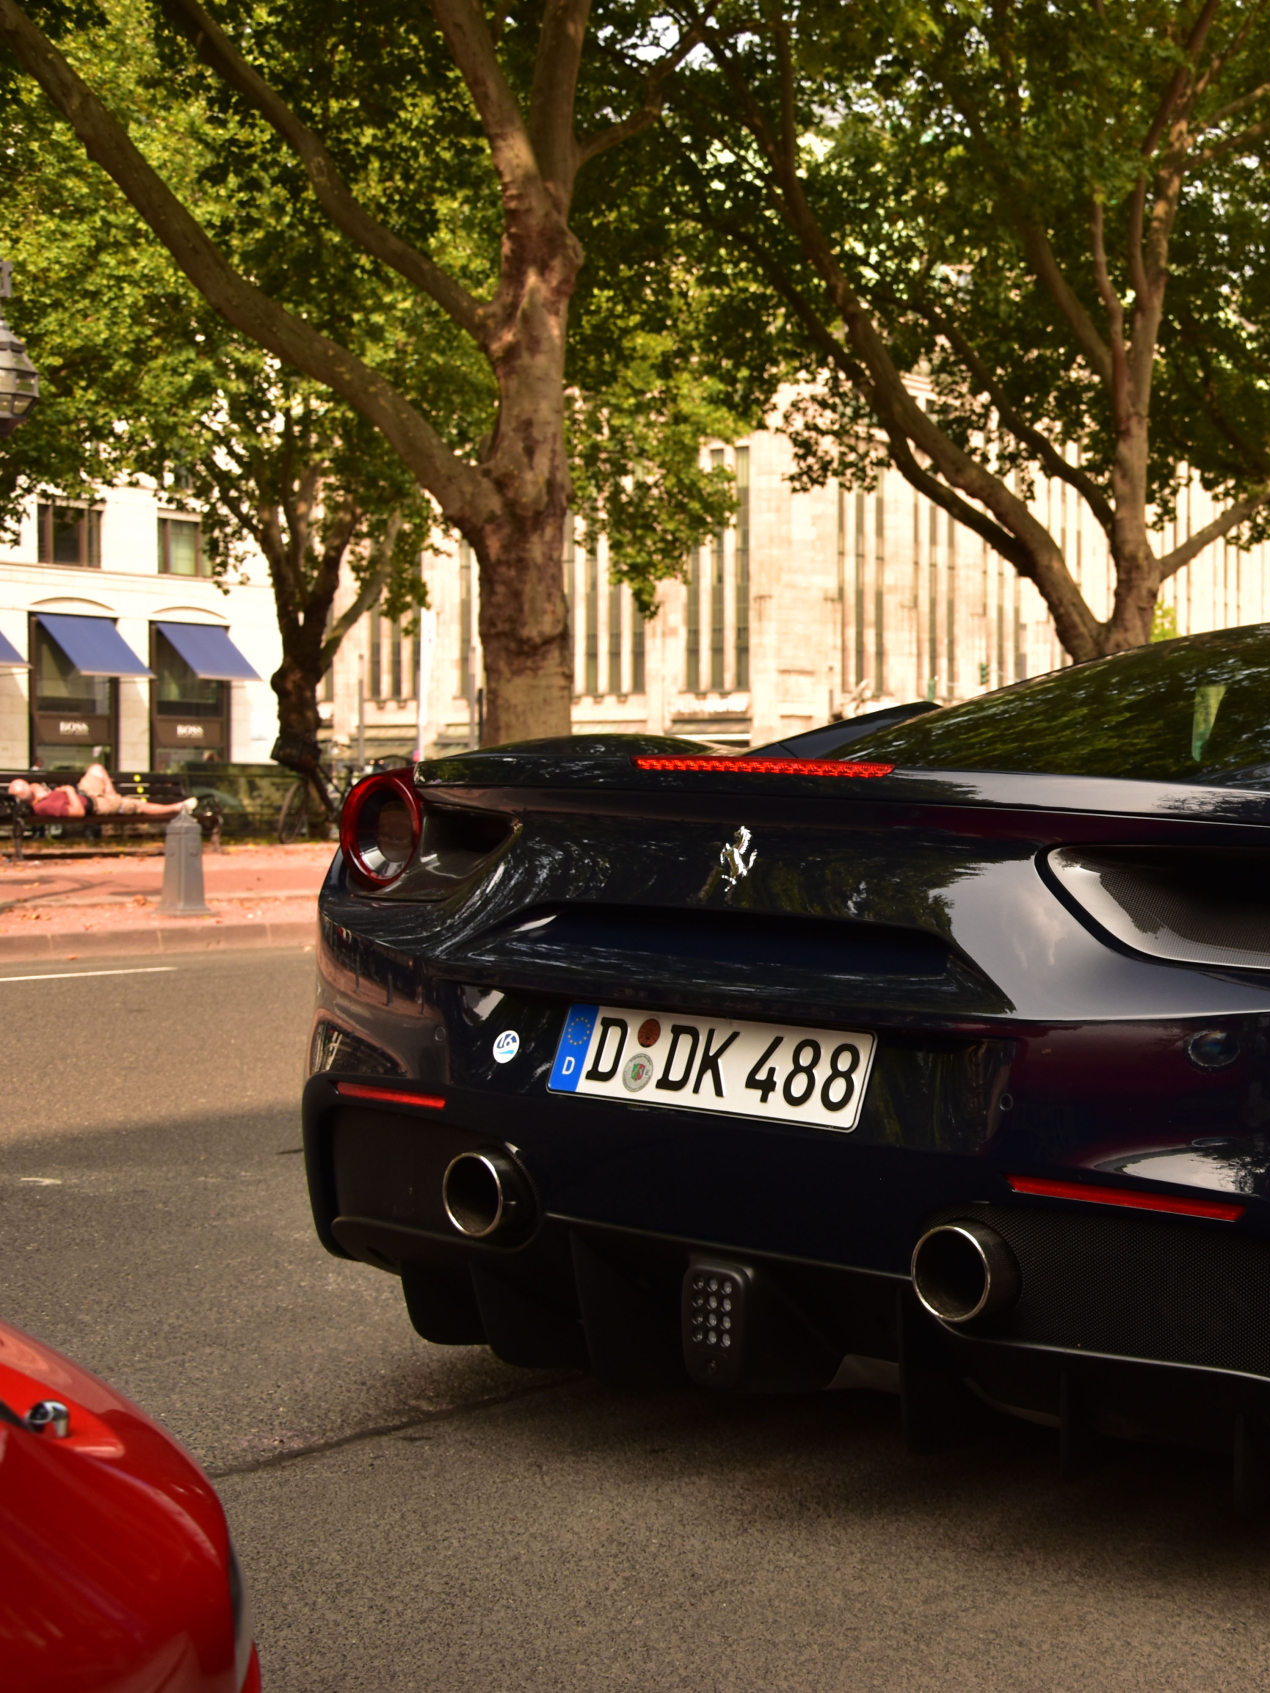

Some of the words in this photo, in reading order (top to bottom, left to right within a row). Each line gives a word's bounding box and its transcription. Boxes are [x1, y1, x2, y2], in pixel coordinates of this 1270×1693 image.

[59, 720, 90, 732] BOSS
[176, 724, 205, 734] BOSS
[561, 1056, 576, 1075] D
[585, 1016, 629, 1082] D
[655, 1023, 741, 1098] DK
[744, 1035, 861, 1112] 488
